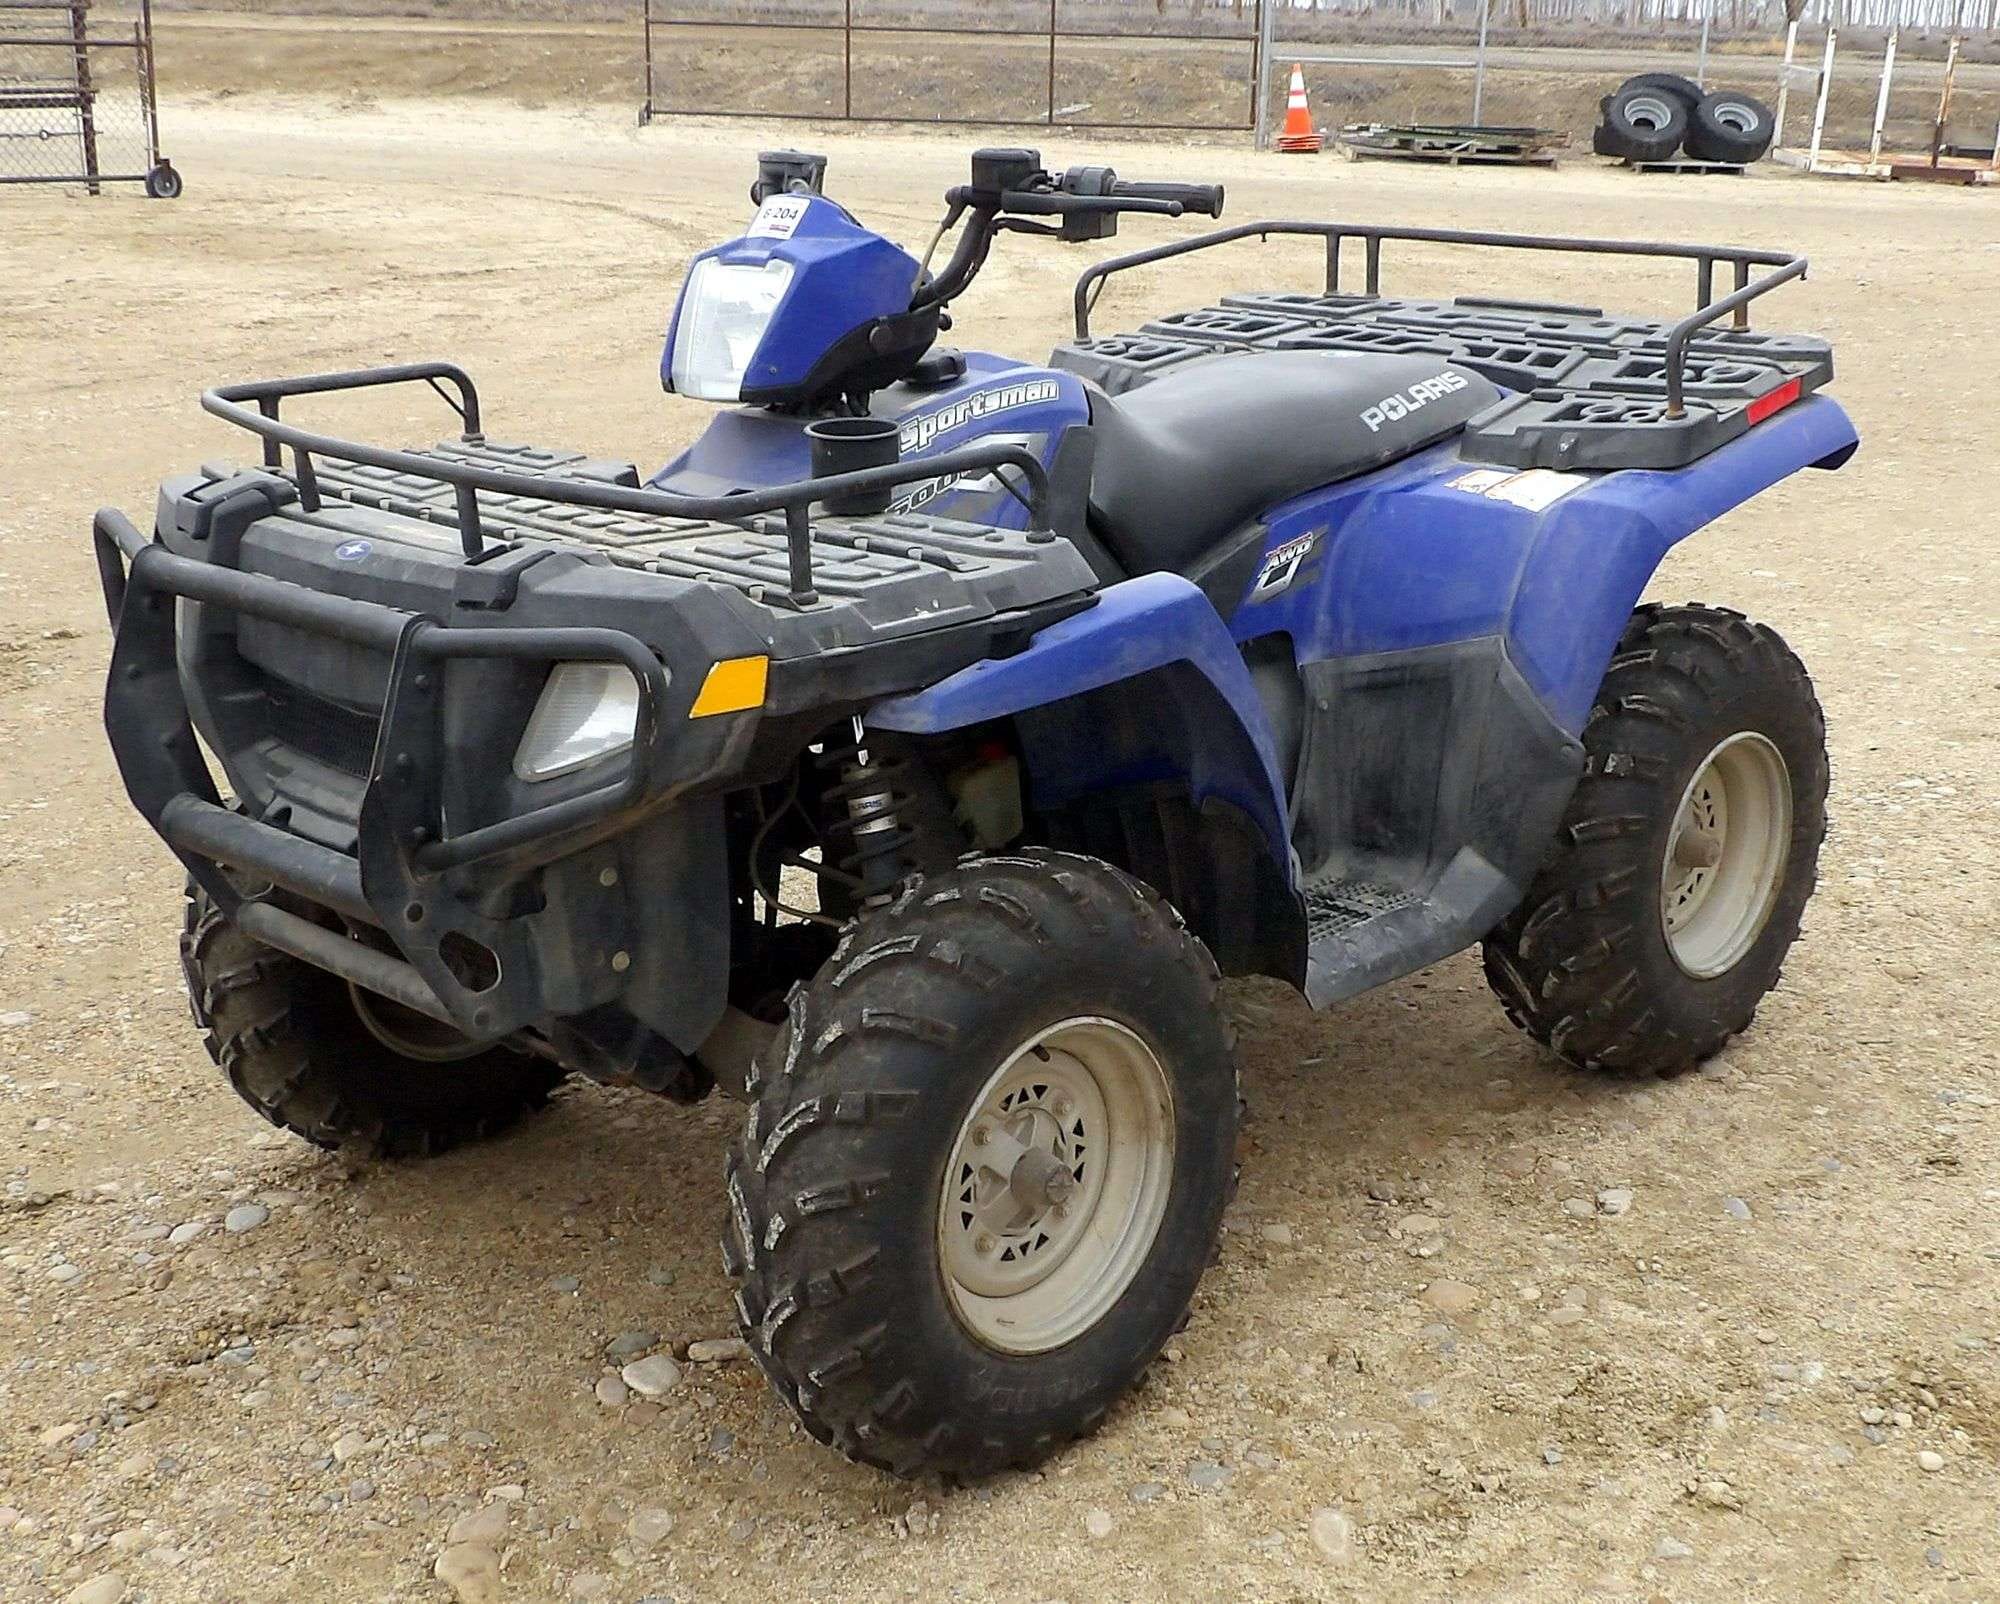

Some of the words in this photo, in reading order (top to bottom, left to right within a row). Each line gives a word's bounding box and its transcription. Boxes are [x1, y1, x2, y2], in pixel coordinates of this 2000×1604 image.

[900, 379, 1060, 455] Sportsman
[1359, 370, 1469, 432] POLARIS
[1263, 539, 1313, 572] AWD
